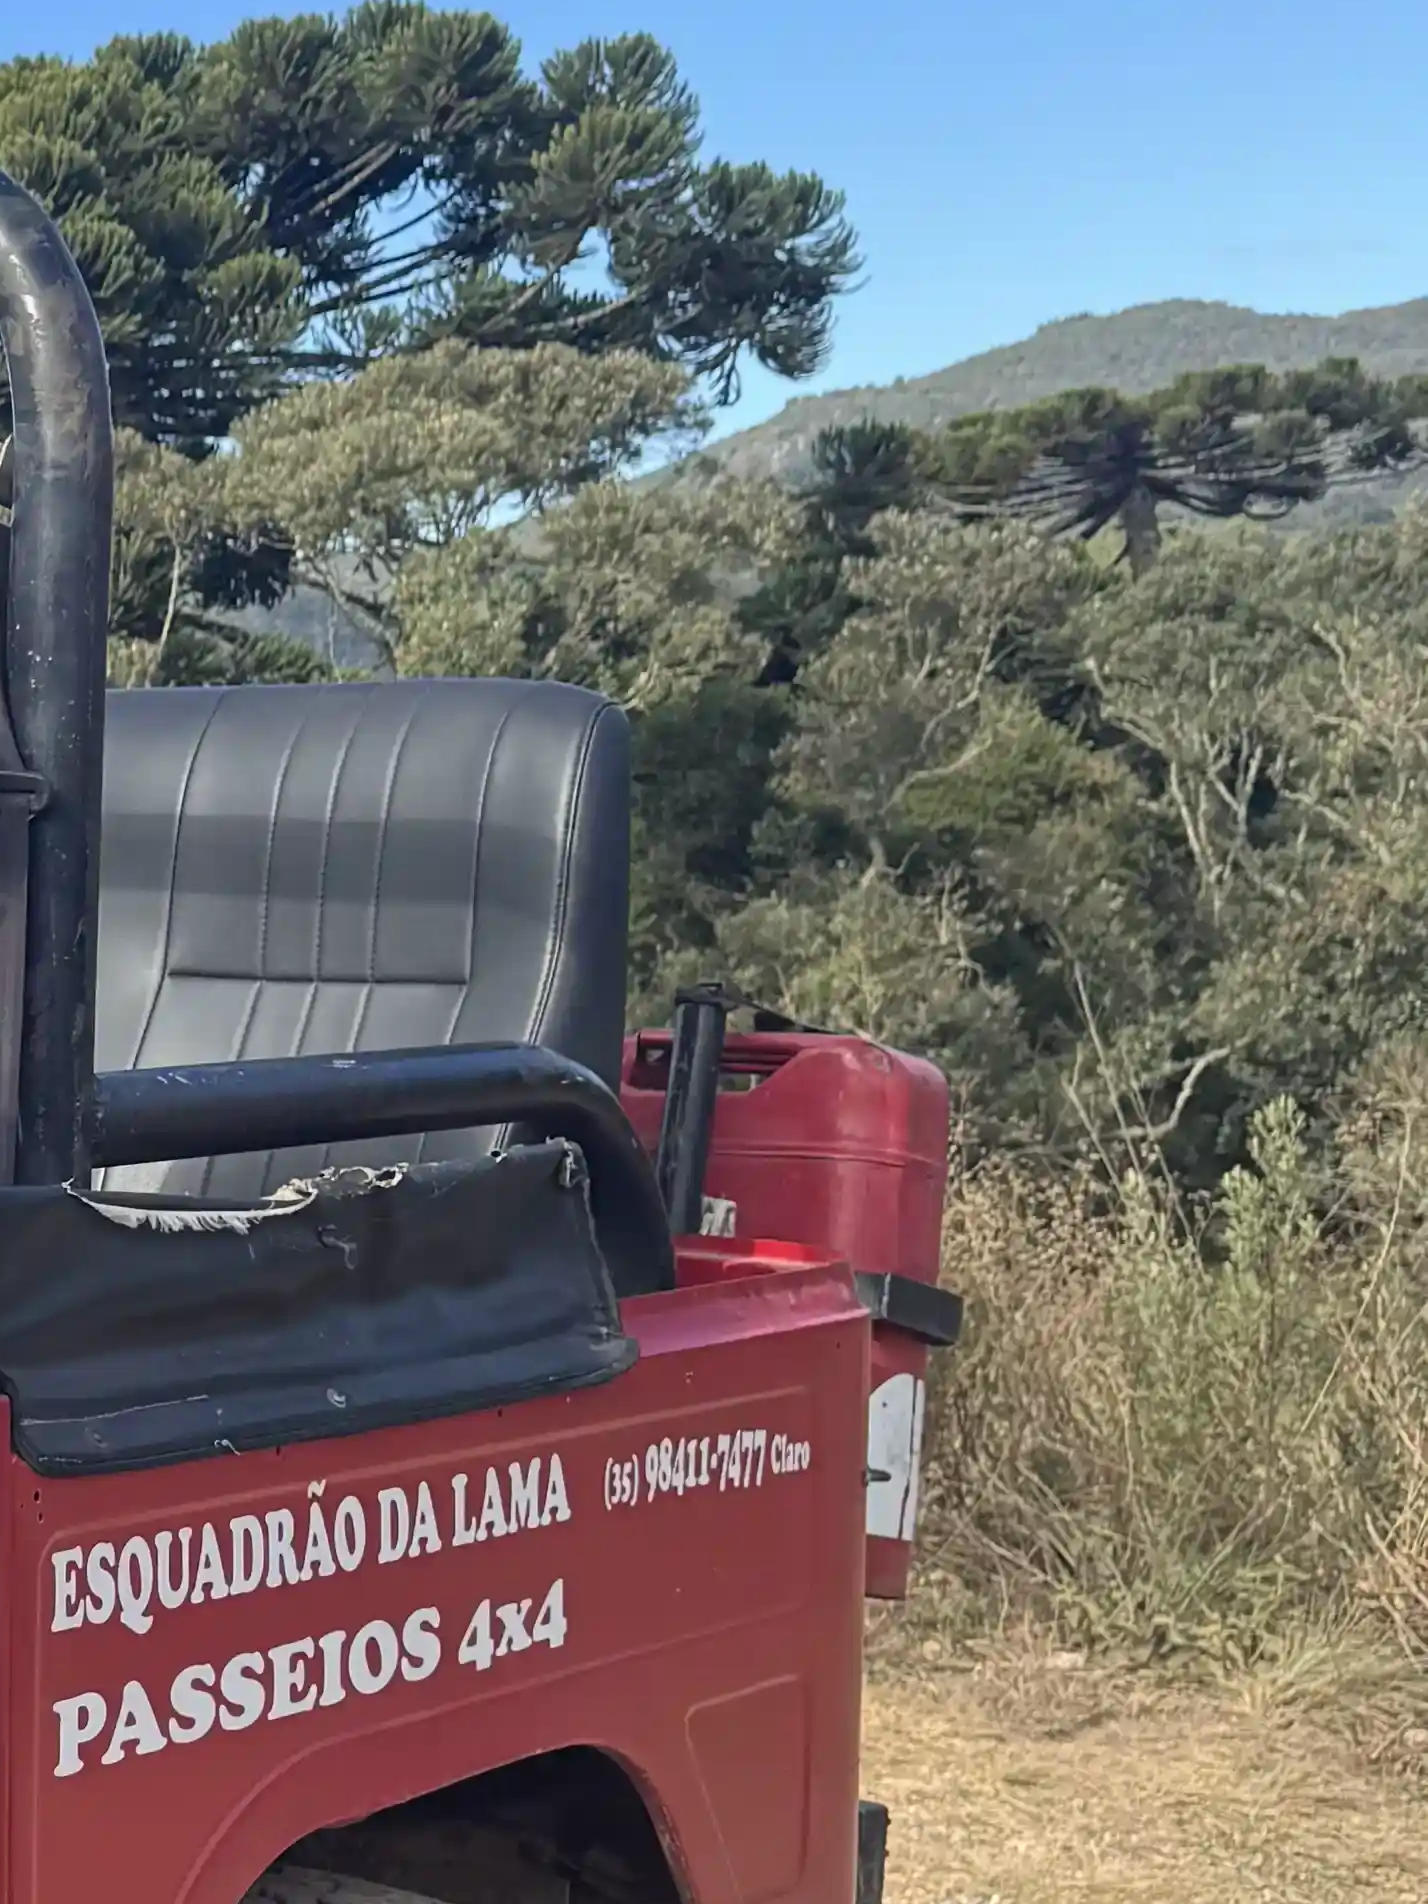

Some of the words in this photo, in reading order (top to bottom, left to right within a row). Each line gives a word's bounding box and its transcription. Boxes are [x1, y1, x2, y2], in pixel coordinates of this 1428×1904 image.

[50, 1479, 366, 1636] ESQUADRÃO
[377, 1480, 443, 1566] DA
[451, 1453, 573, 1548] LAMA
[604, 1453, 639, 1511] (35)
[645, 1429, 767, 1503] 98411-7477
[770, 1433, 811, 1475] Claro
[52, 1606, 442, 1779] PASSEIOS
[457, 1578, 569, 1672] 4x4
